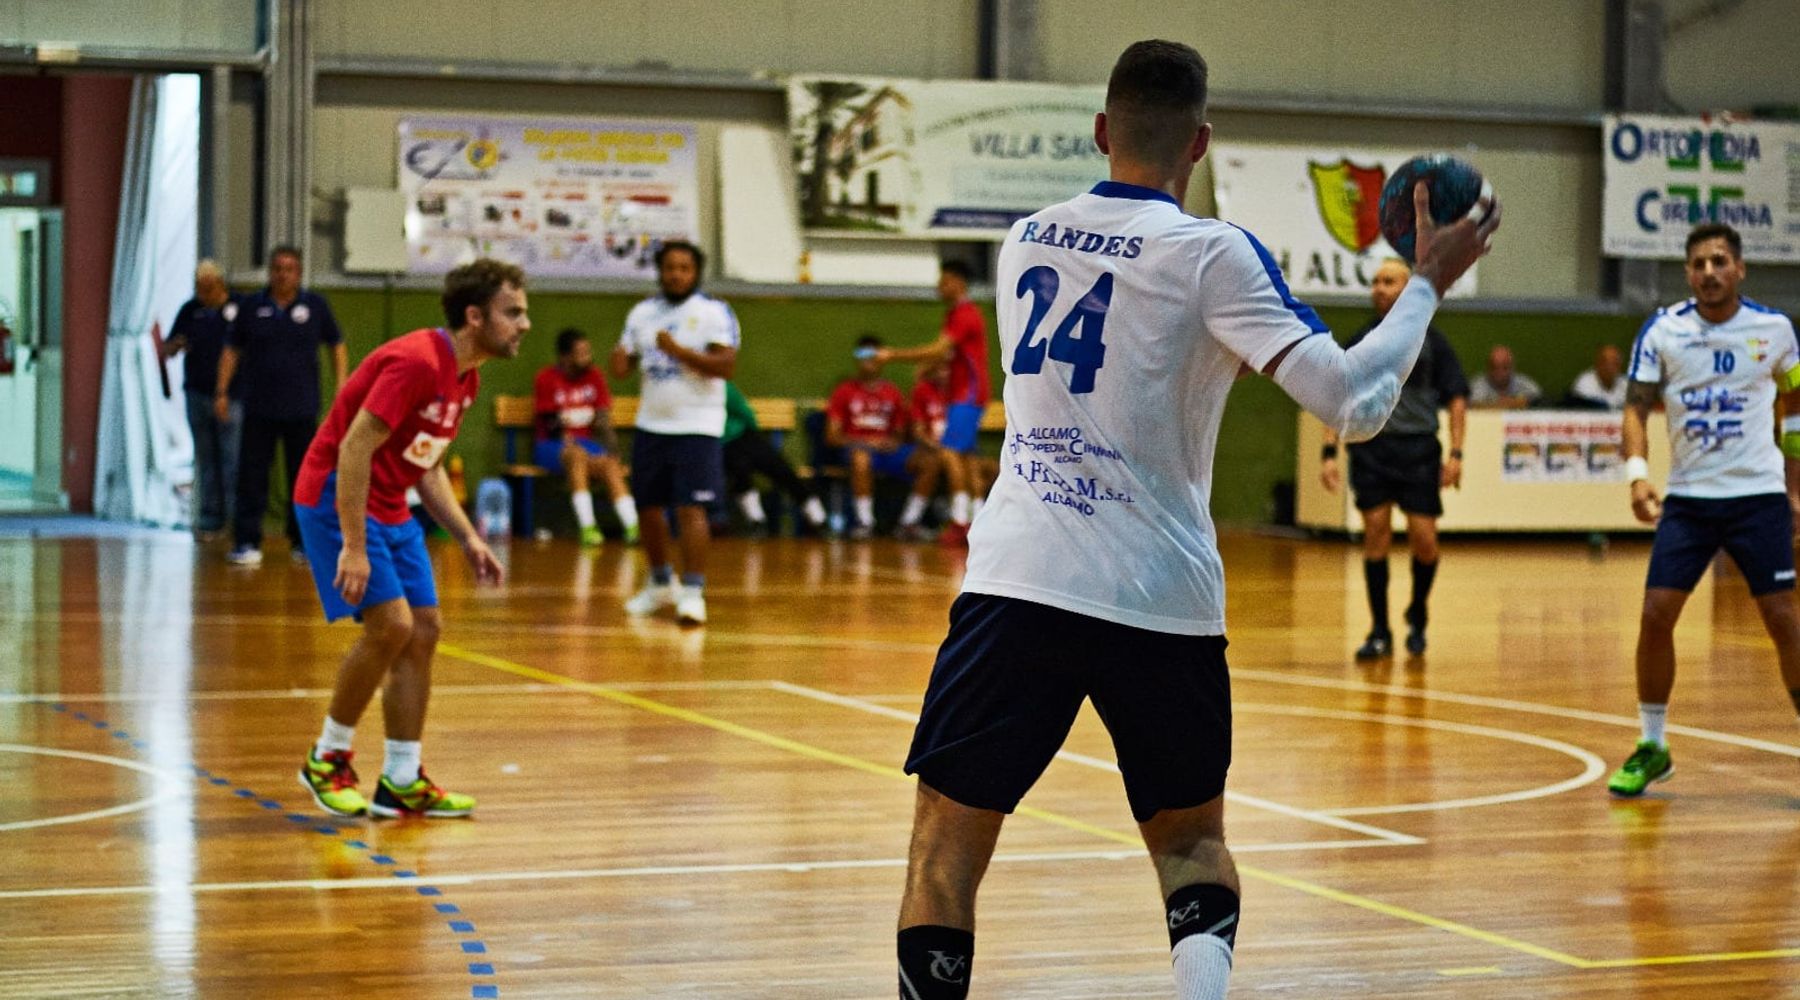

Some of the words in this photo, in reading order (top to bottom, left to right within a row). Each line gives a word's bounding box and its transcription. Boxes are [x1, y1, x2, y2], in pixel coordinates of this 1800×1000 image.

[1019, 221, 1143, 259] RANDES
[1011, 265, 1114, 394] 24
[1713, 351, 1735, 374] 10
[1027, 427, 1080, 440] ALCAMO
